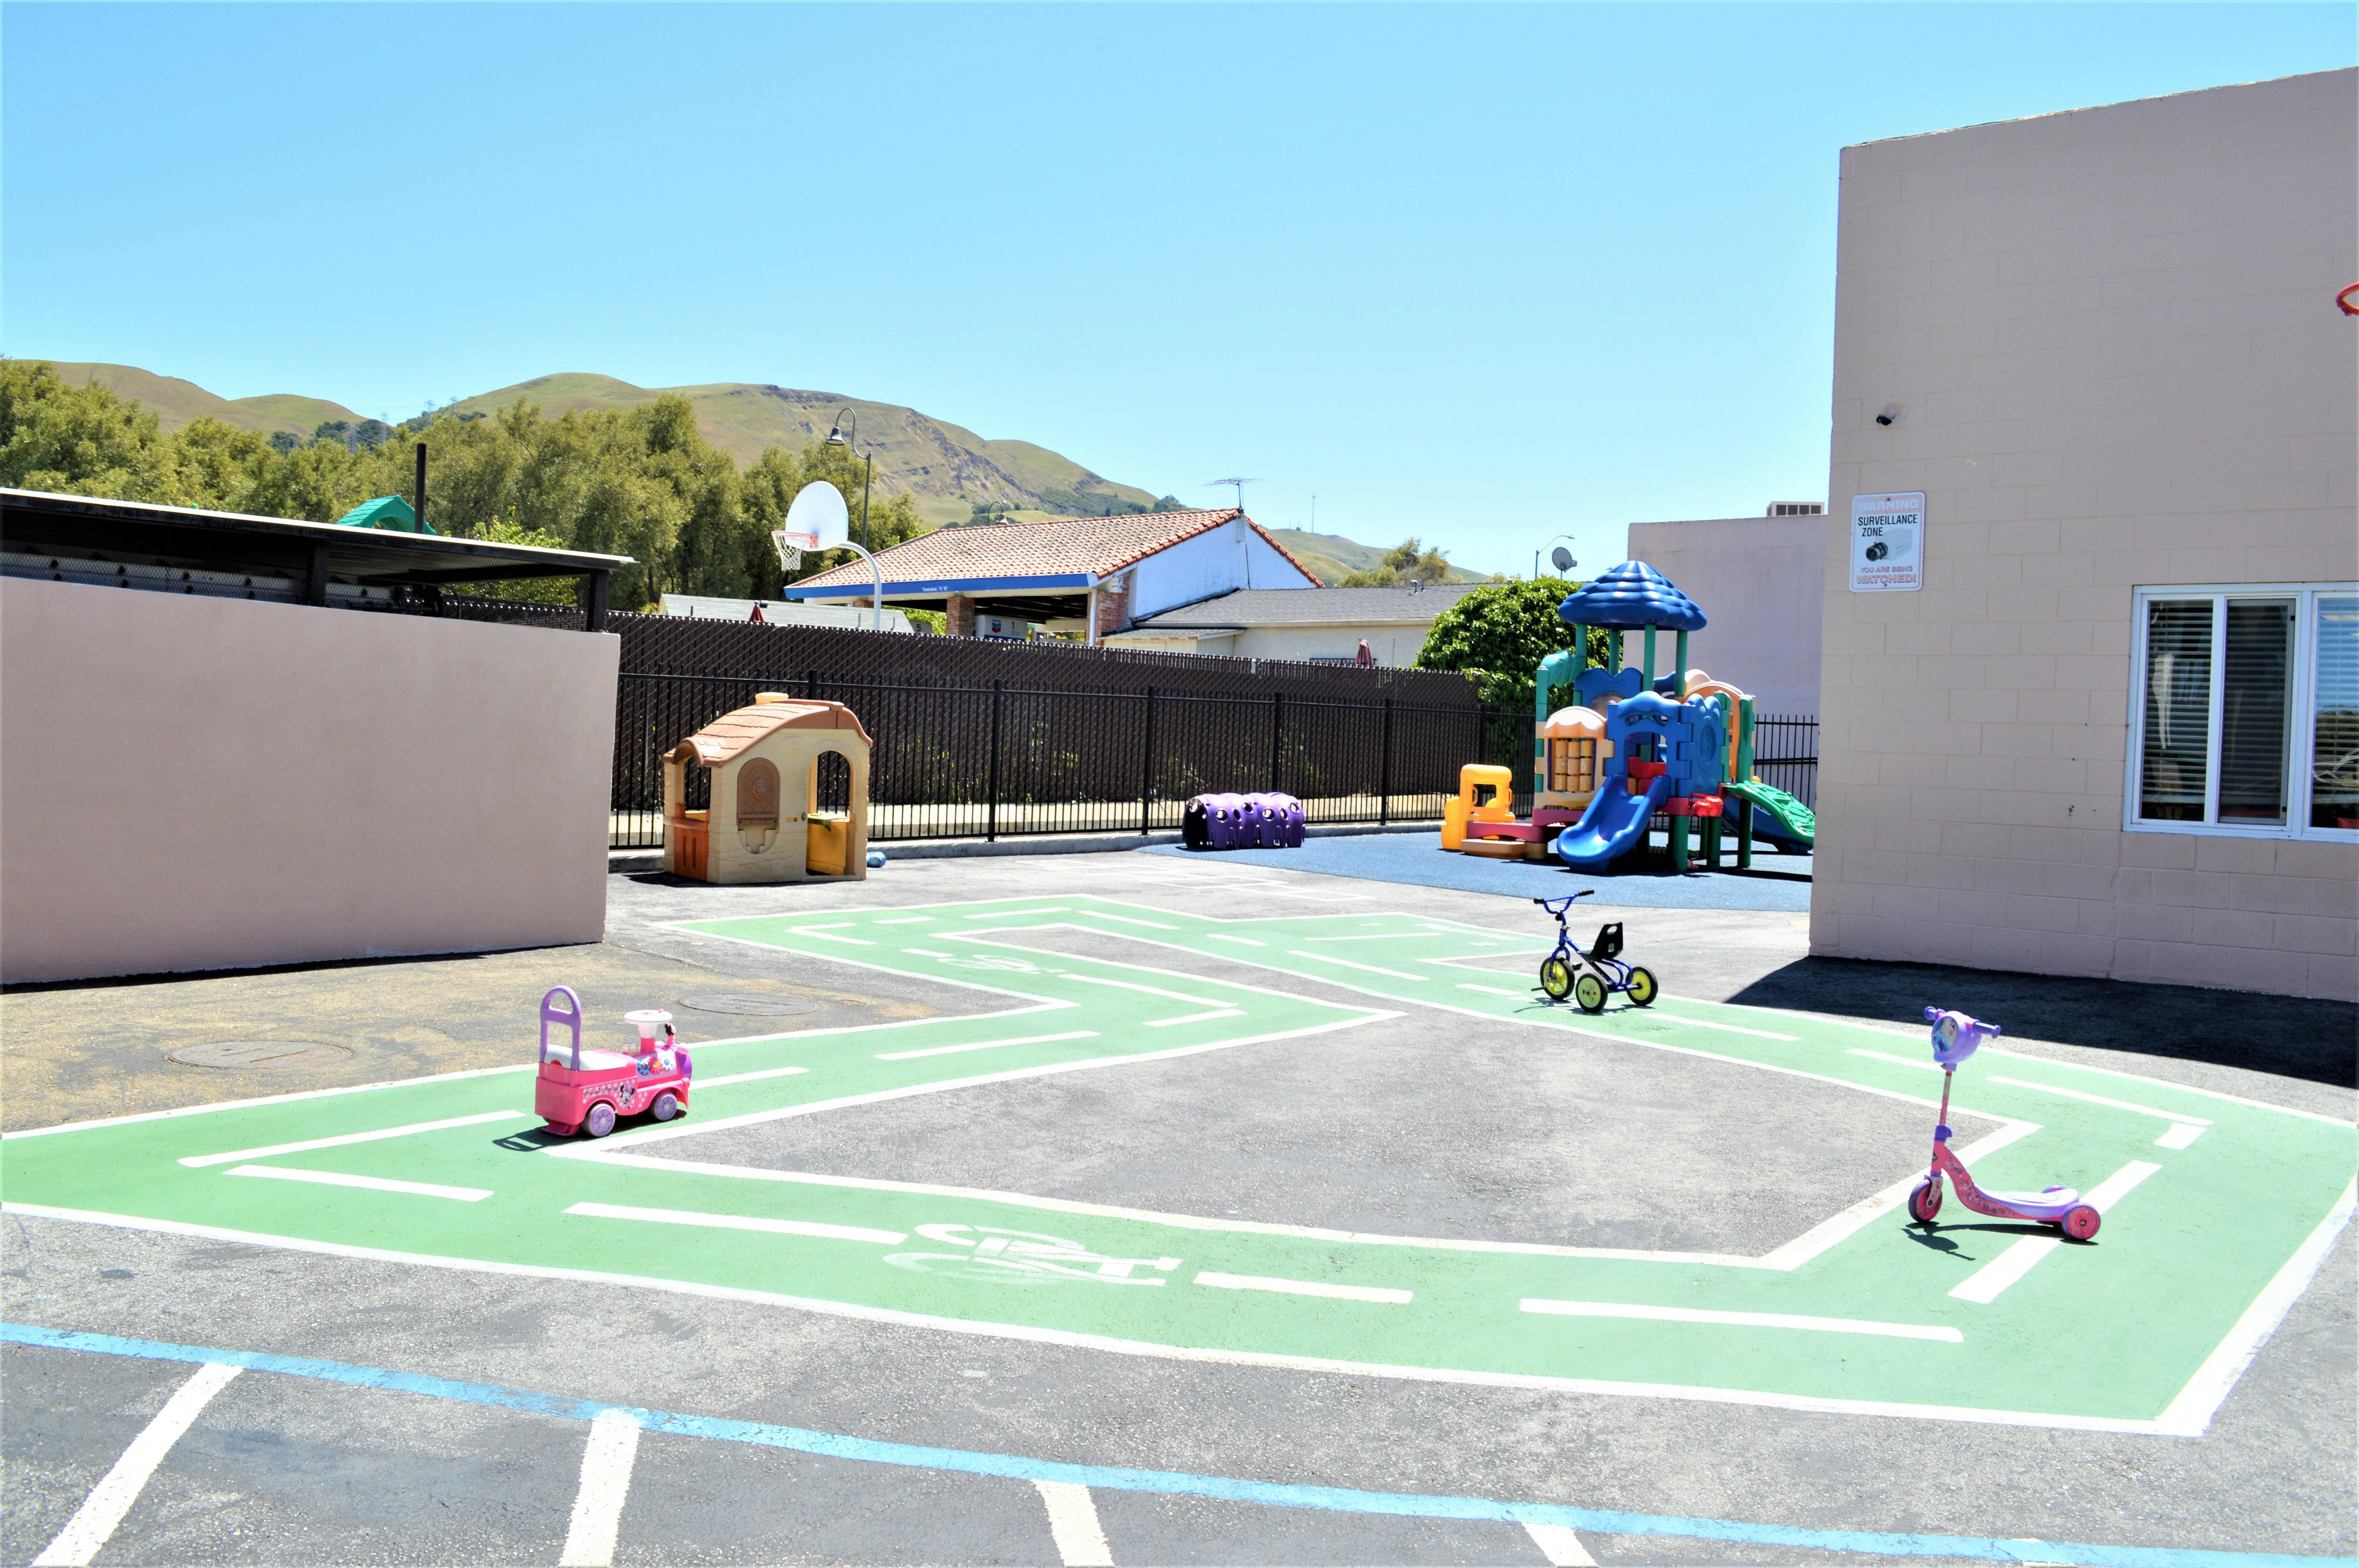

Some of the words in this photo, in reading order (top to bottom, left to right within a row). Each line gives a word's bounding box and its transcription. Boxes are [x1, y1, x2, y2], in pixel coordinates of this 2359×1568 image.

[1858, 499, 1918, 511] WARNING
[1858, 514, 1917, 526] SURVEILLANCE
[1862, 527, 1883, 537] ZONE
[1856, 573, 1917, 584] WATCHED!
[916, 624, 921, 632] 5
[1012, 621, 1014, 630] 1
